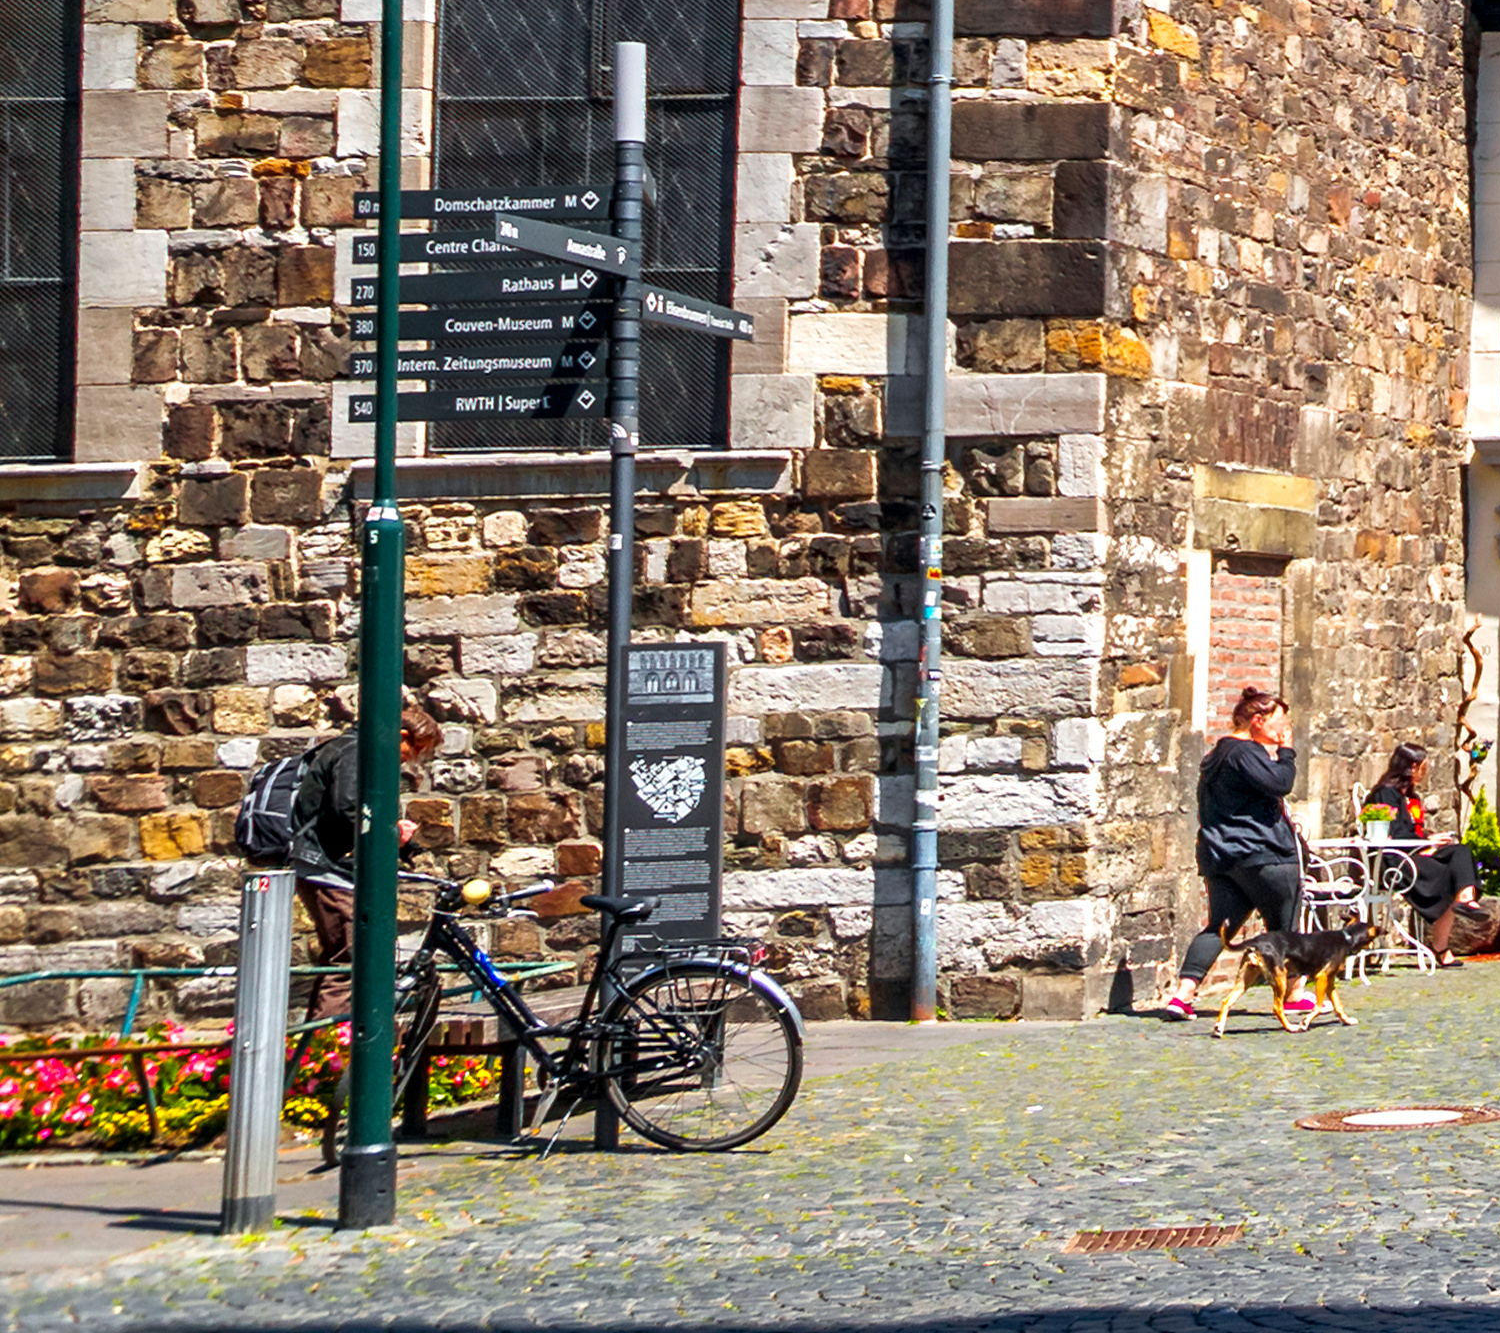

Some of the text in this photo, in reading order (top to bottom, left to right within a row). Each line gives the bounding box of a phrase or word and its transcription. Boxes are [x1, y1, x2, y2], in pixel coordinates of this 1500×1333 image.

[358, 200, 371, 214] 60
[434, 195, 556, 213] Domschatzkammer
[564, 195, 577, 208] M
[357, 243, 375, 257] 150
[425, 239, 469, 255] Centre
[355, 276, 555, 299] 270 Rathaus
[355, 315, 574, 334] 380 Couven-Museum M
[354, 355, 574, 374] 370 Intern. Zeitungsmuseum M
[354, 401, 373, 416] 540
[456, 396, 495, 412] RWTH
[505, 396, 541, 413] Super
[369, 529, 379, 544] 5
